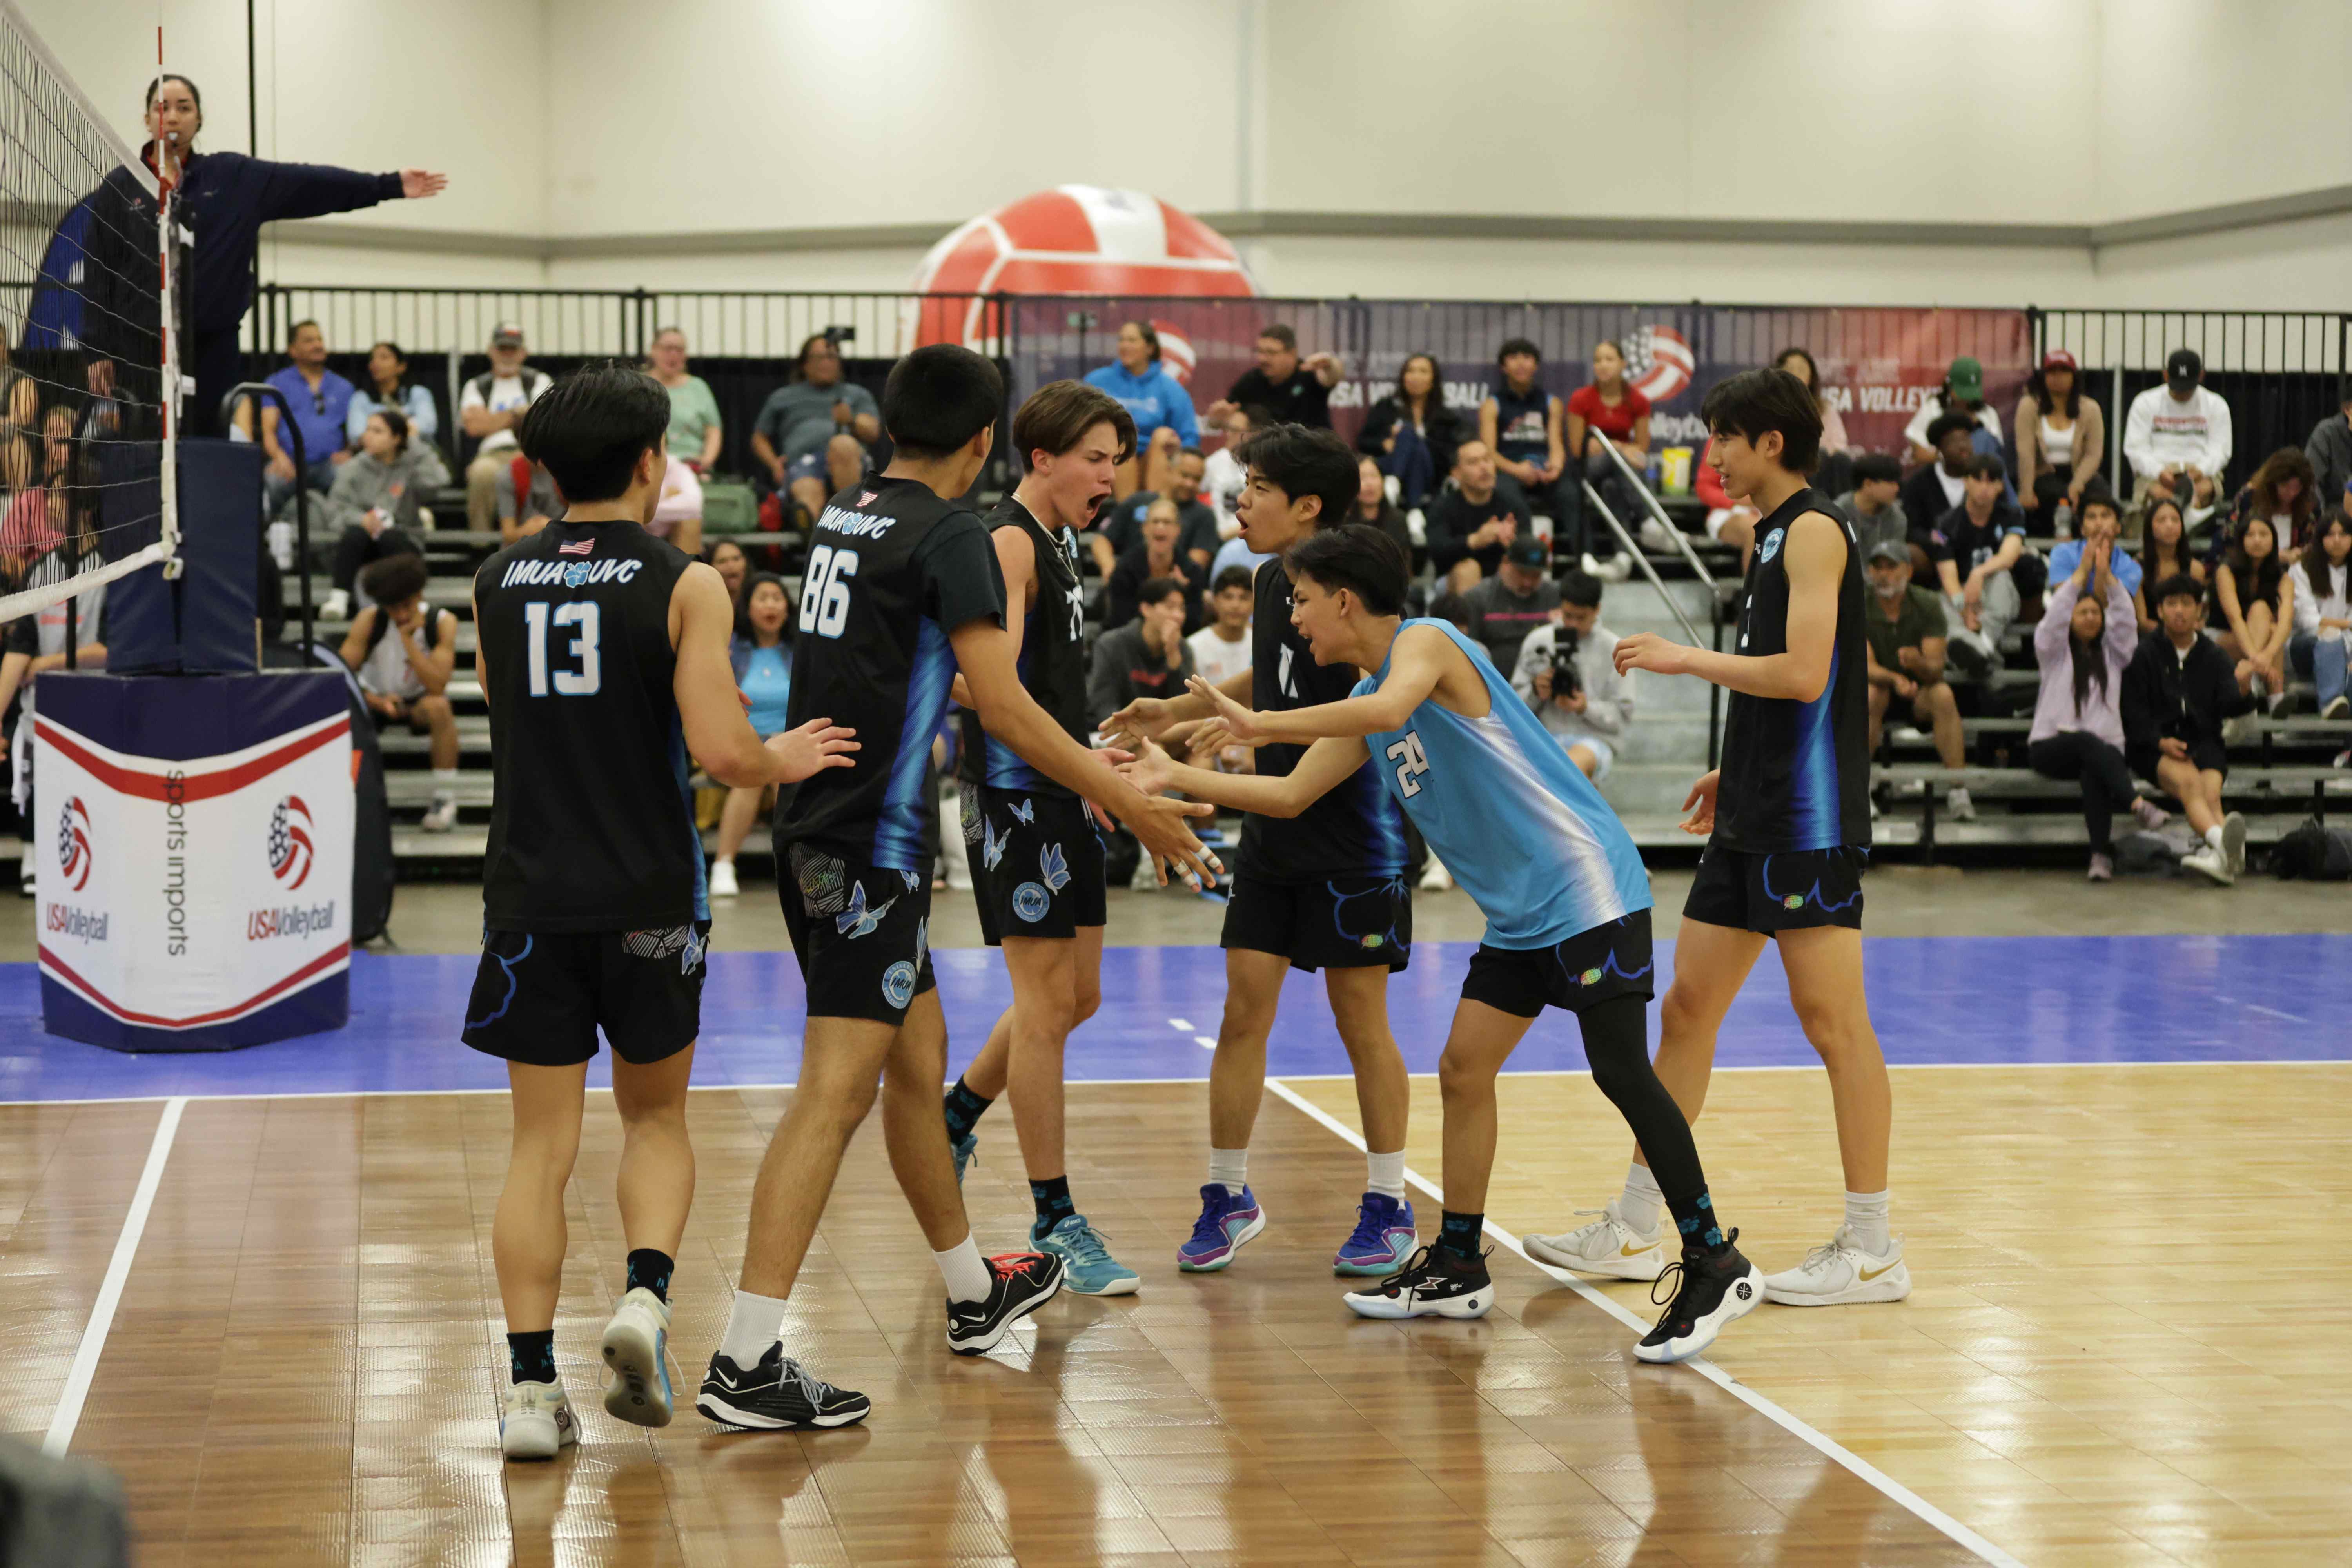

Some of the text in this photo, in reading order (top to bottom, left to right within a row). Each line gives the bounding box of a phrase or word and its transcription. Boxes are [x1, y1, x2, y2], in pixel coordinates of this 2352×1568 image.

[817, 505, 897, 540] IMUA UVC
[501, 559, 643, 588] IMUA UVC
[799, 544, 859, 639] 86
[525, 601, 601, 697] 13
[162, 769, 188, 851] sports
[162, 857, 189, 956] imports
[248, 900, 334, 942] USAVolleyball
